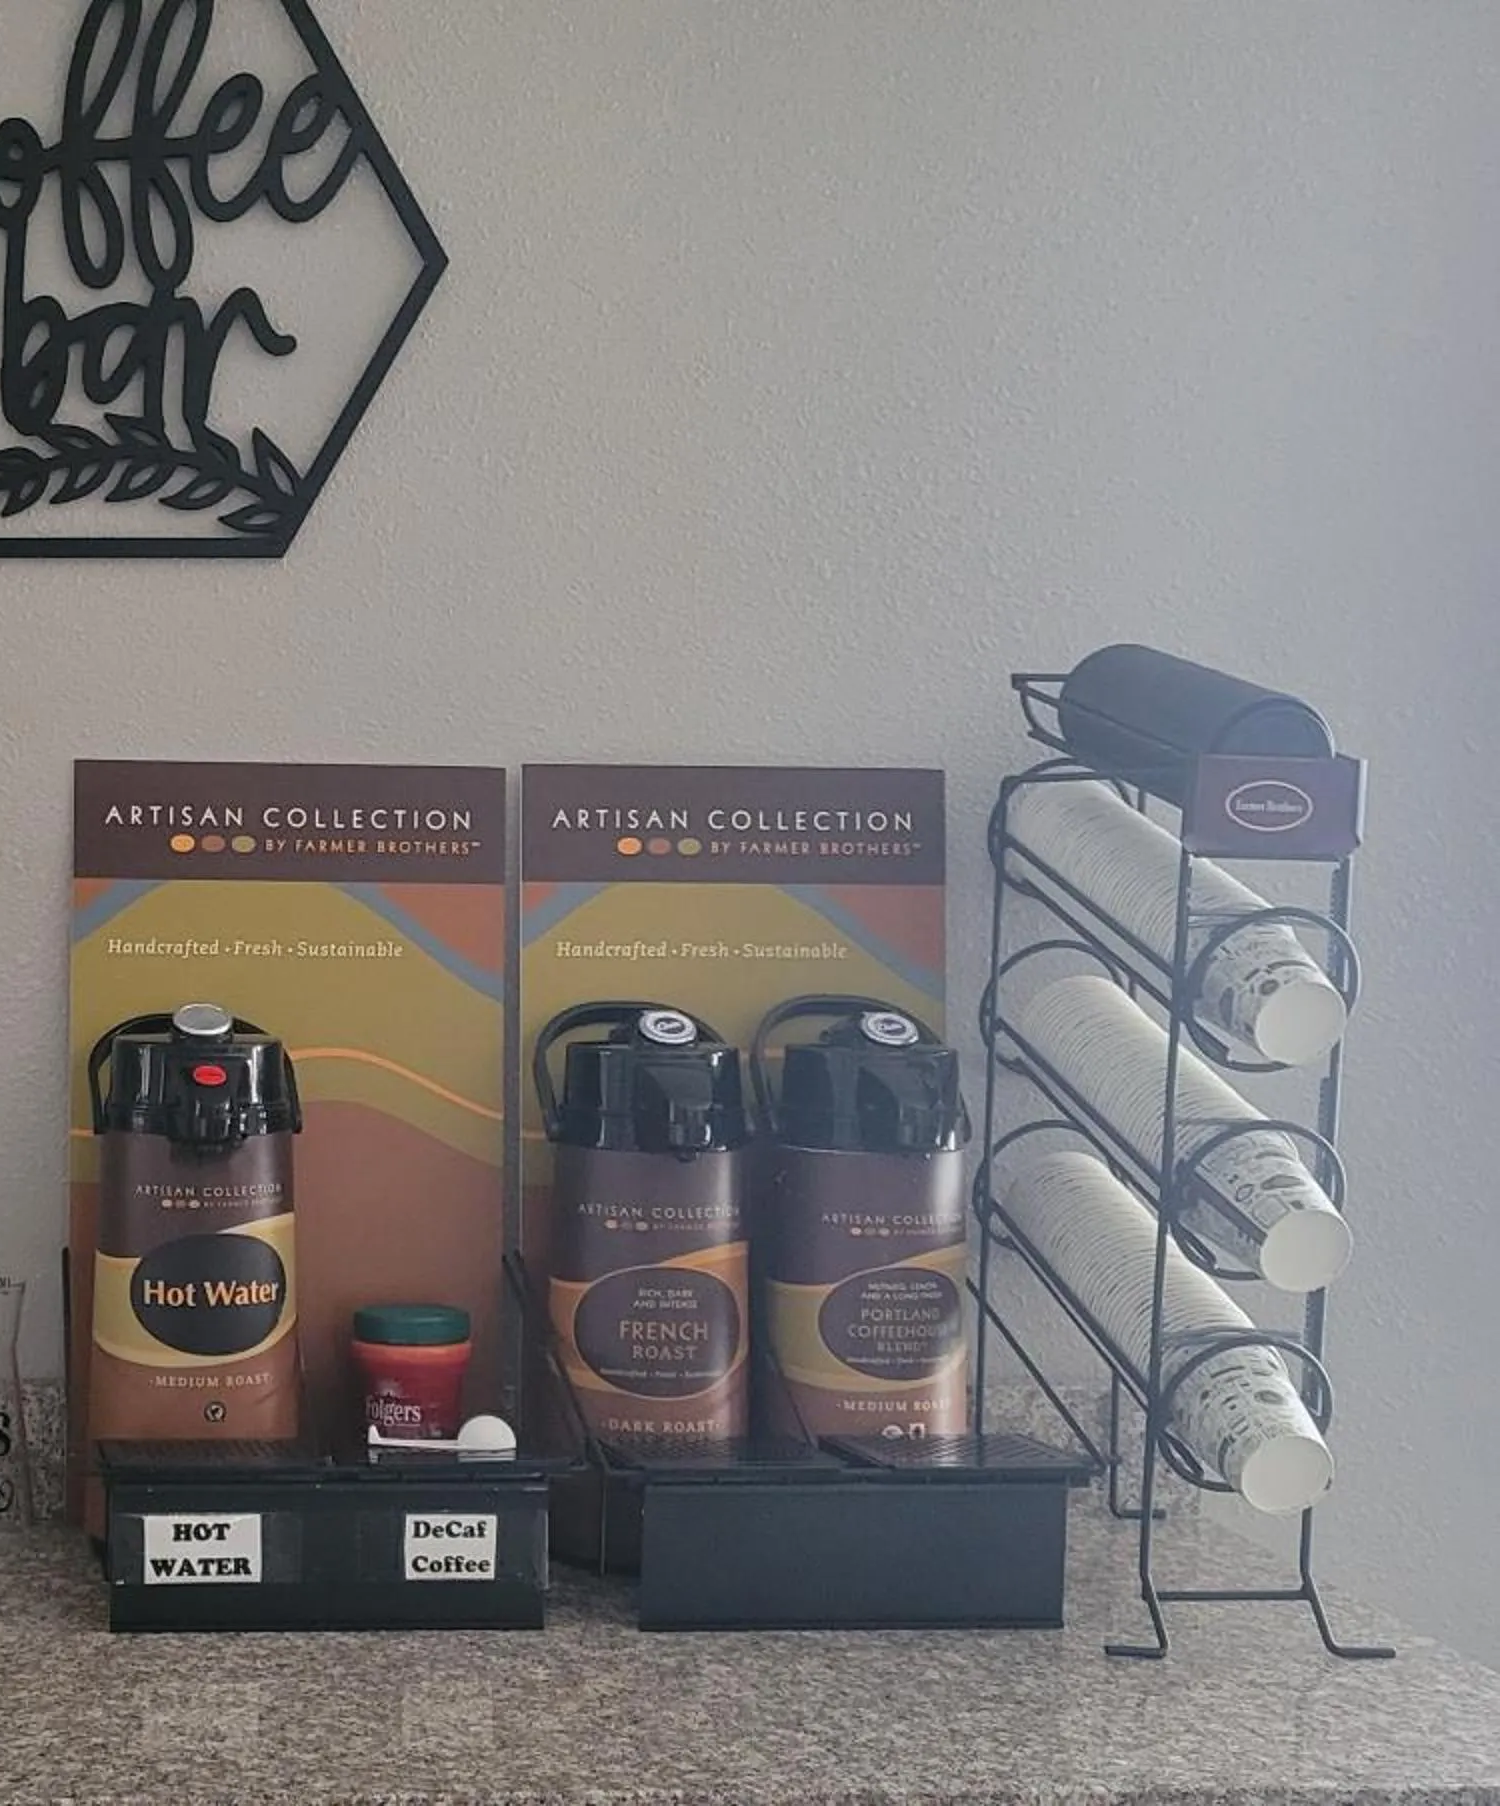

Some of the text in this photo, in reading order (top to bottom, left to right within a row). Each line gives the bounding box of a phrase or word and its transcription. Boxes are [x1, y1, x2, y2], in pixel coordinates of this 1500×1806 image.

[0, 250, 298, 436] bar
[105, 804, 472, 831] ARTISAN COLLECTION
[551, 808, 913, 832] ARTISAN COLLECTION
[265, 839, 286, 852] BY
[295, 840, 367, 854] FARMER
[711, 842, 731, 854] BY
[739, 842, 810, 855] FARMER
[107, 938, 404, 959] Handcrafted Fresh Sustainable
[555, 940, 848, 962] Handcrafted Fresh Sustainable
[577, 1203, 644, 1218] ARTISAN
[143, 1279, 280, 1308] Hot Water
[860, 1308, 941, 1322] PORTLAND
[619, 1320, 709, 1342] FRENCH
[847, 1323, 956, 1339] COFFEEHOU
[631, 1344, 698, 1361] ROAST
[154, 1372, 270, 1388] MEDIUM ROAST
[607, 1418, 654, 1433] DARK
[171, 1523, 232, 1542] HOT
[412, 1520, 488, 1539] DeCaf
[149, 1557, 253, 1578] WATER
[411, 1555, 492, 1574] Coffee
